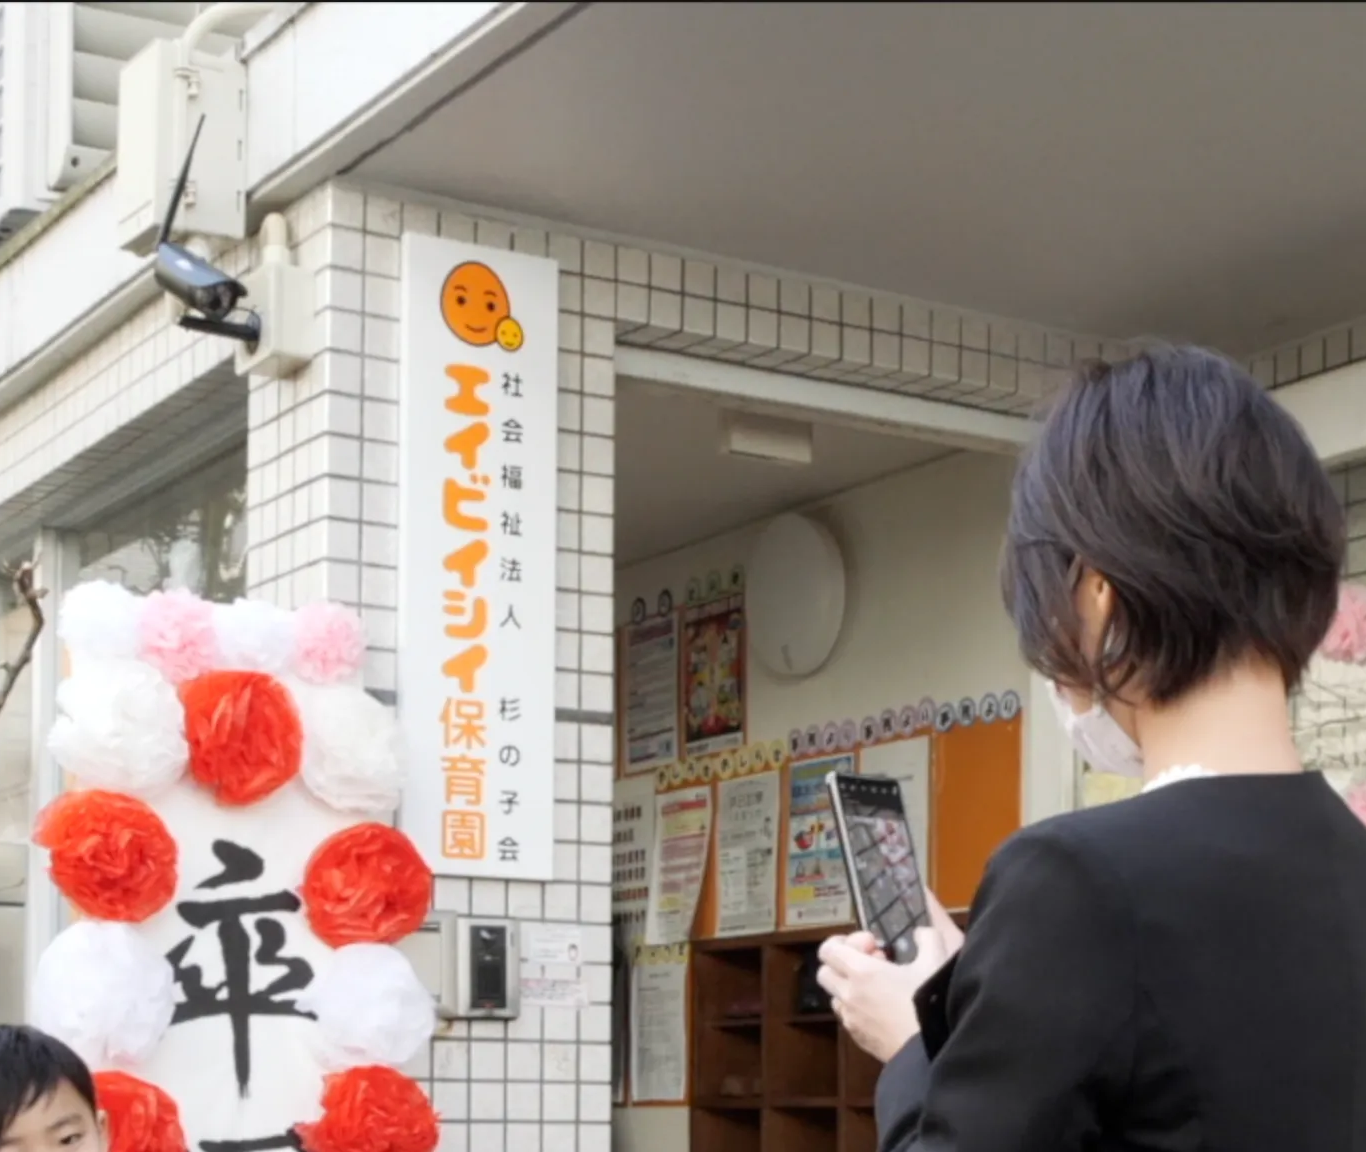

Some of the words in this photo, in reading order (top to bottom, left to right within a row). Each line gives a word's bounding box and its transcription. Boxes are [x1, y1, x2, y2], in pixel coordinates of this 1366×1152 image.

[439, 362, 493, 861] エイビイシイ保育園
[499, 371, 524, 629] 社会福祉法人
[497, 696, 523, 863] 杉の子会
